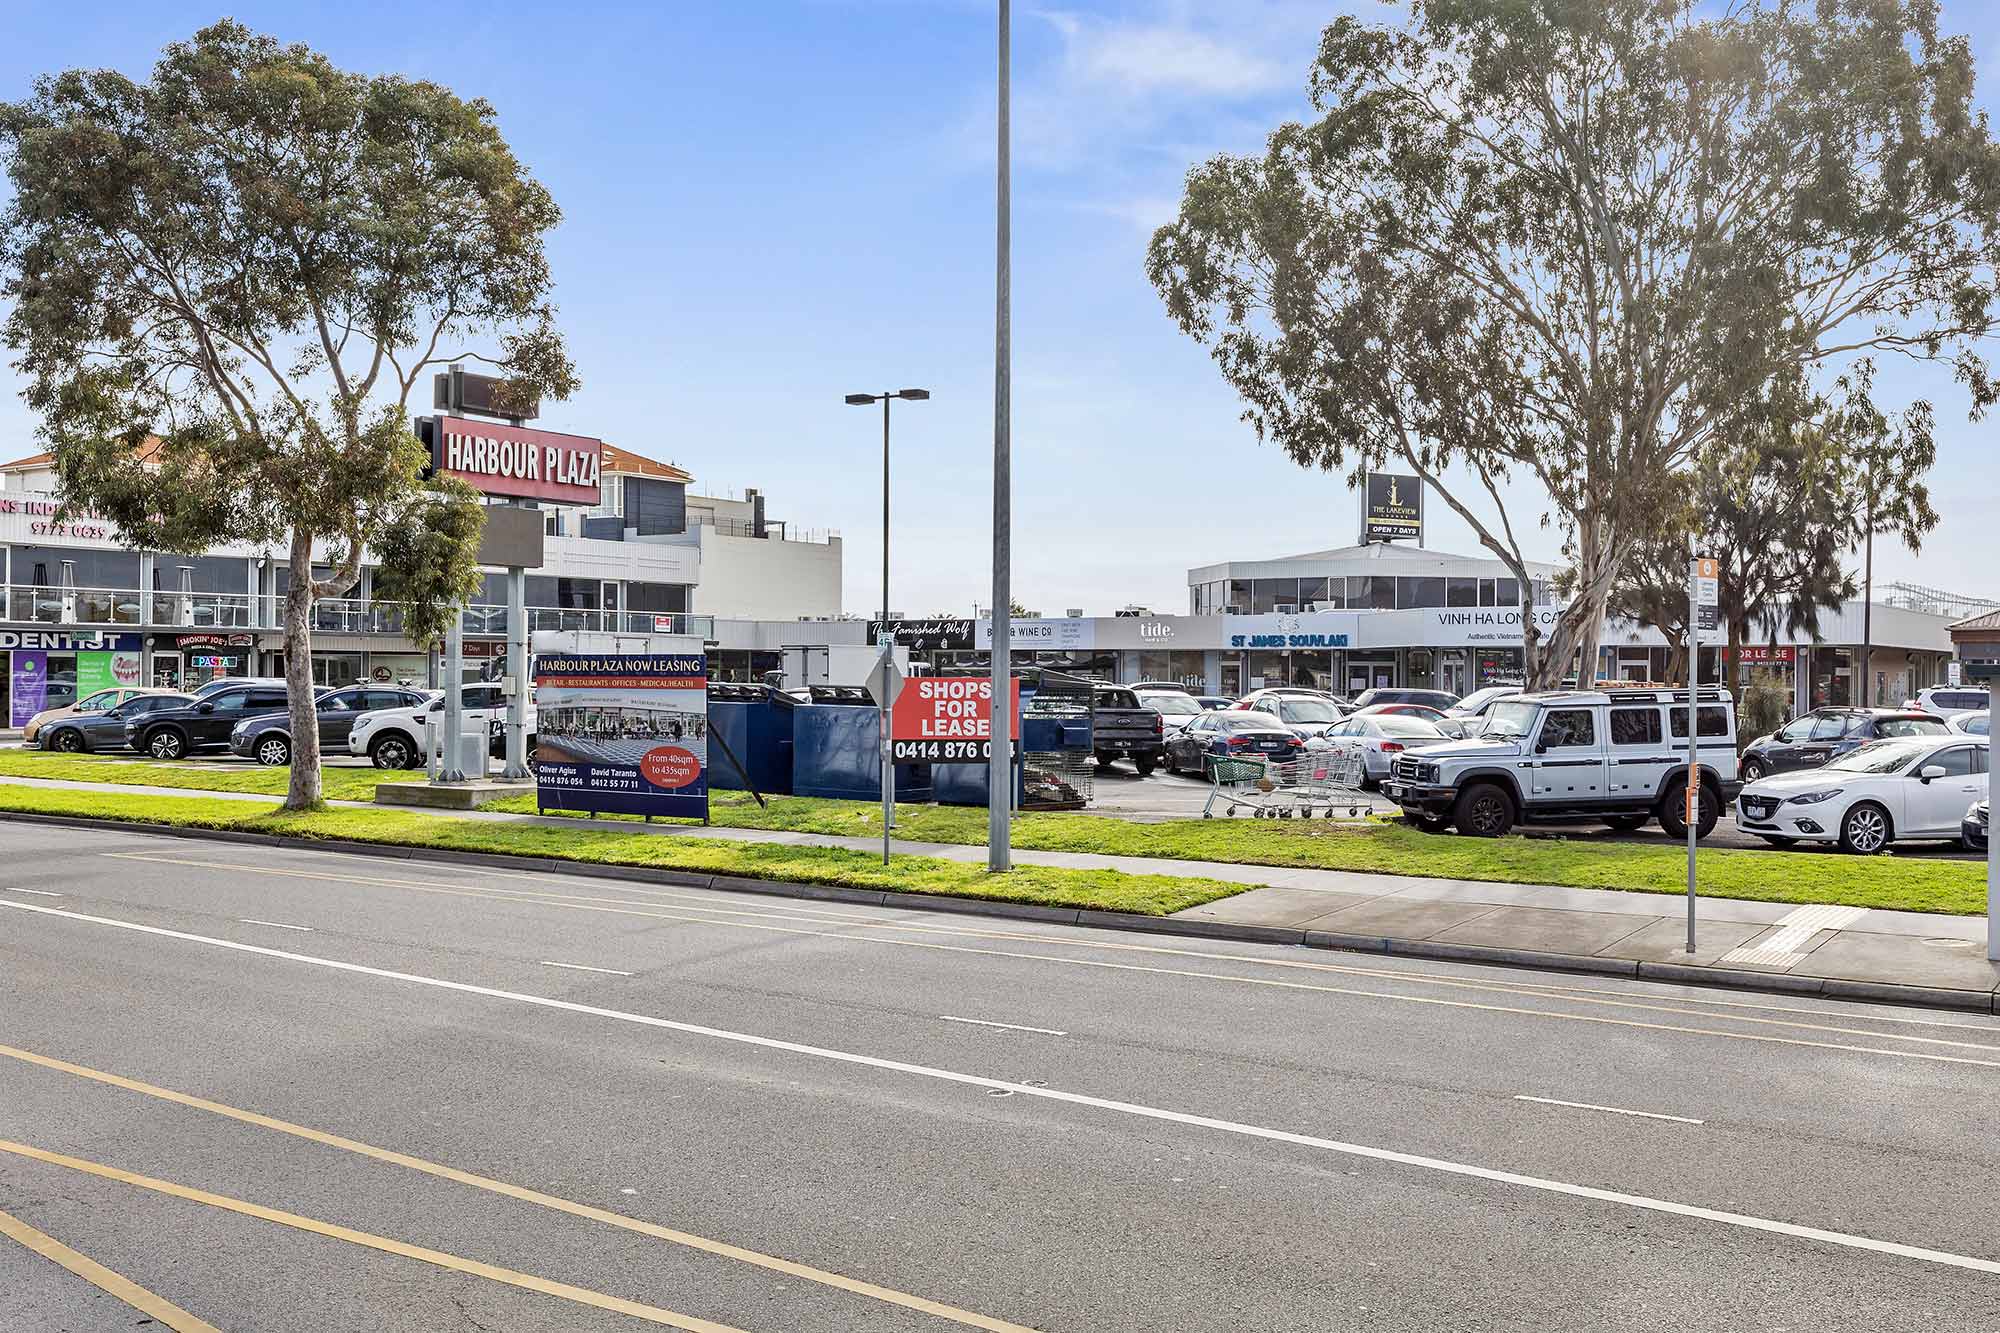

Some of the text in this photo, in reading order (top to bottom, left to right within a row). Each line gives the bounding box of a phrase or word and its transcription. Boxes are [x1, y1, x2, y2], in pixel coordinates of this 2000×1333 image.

[447, 432, 601, 488] HARBOUR PLAZA
[1386, 506, 1417, 515] LAKEVIEW
[1399, 527, 1417, 535] DAYS
[1438, 612, 1471, 625] VINH
[1475, 612, 1497, 625] HA
[891, 621, 943, 635] Famished
[943, 620, 970, 641] Wolf
[1018, 627, 1039, 637] WINE
[1467, 632, 1496, 640] Authentic
[179, 635, 210, 646] SMOKIN'
[1231, 634, 1348, 648] ST JAMES SOUVLAKI
[1755, 649, 1788, 659] LESE
[199, 656, 229, 667] PASTA
[539, 660, 701, 672] HARBOUR PLAZA NOW LEASING
[919, 681, 992, 699] SHOPS
[934, 700, 978, 718] FOR
[921, 719, 991, 736] LEASE
[895, 742, 940, 758] 0414
[944, 742, 977, 758] 876
[648, 754, 694, 765] From 40sqm
[539, 765, 577, 776] Oliver Agius
[591, 767, 637, 778] David Taranto
[652, 766, 690, 776] to 435sqm
[539, 776, 583, 786] 0414 876 054
[591, 778, 639, 788] 0412 55 77 11
